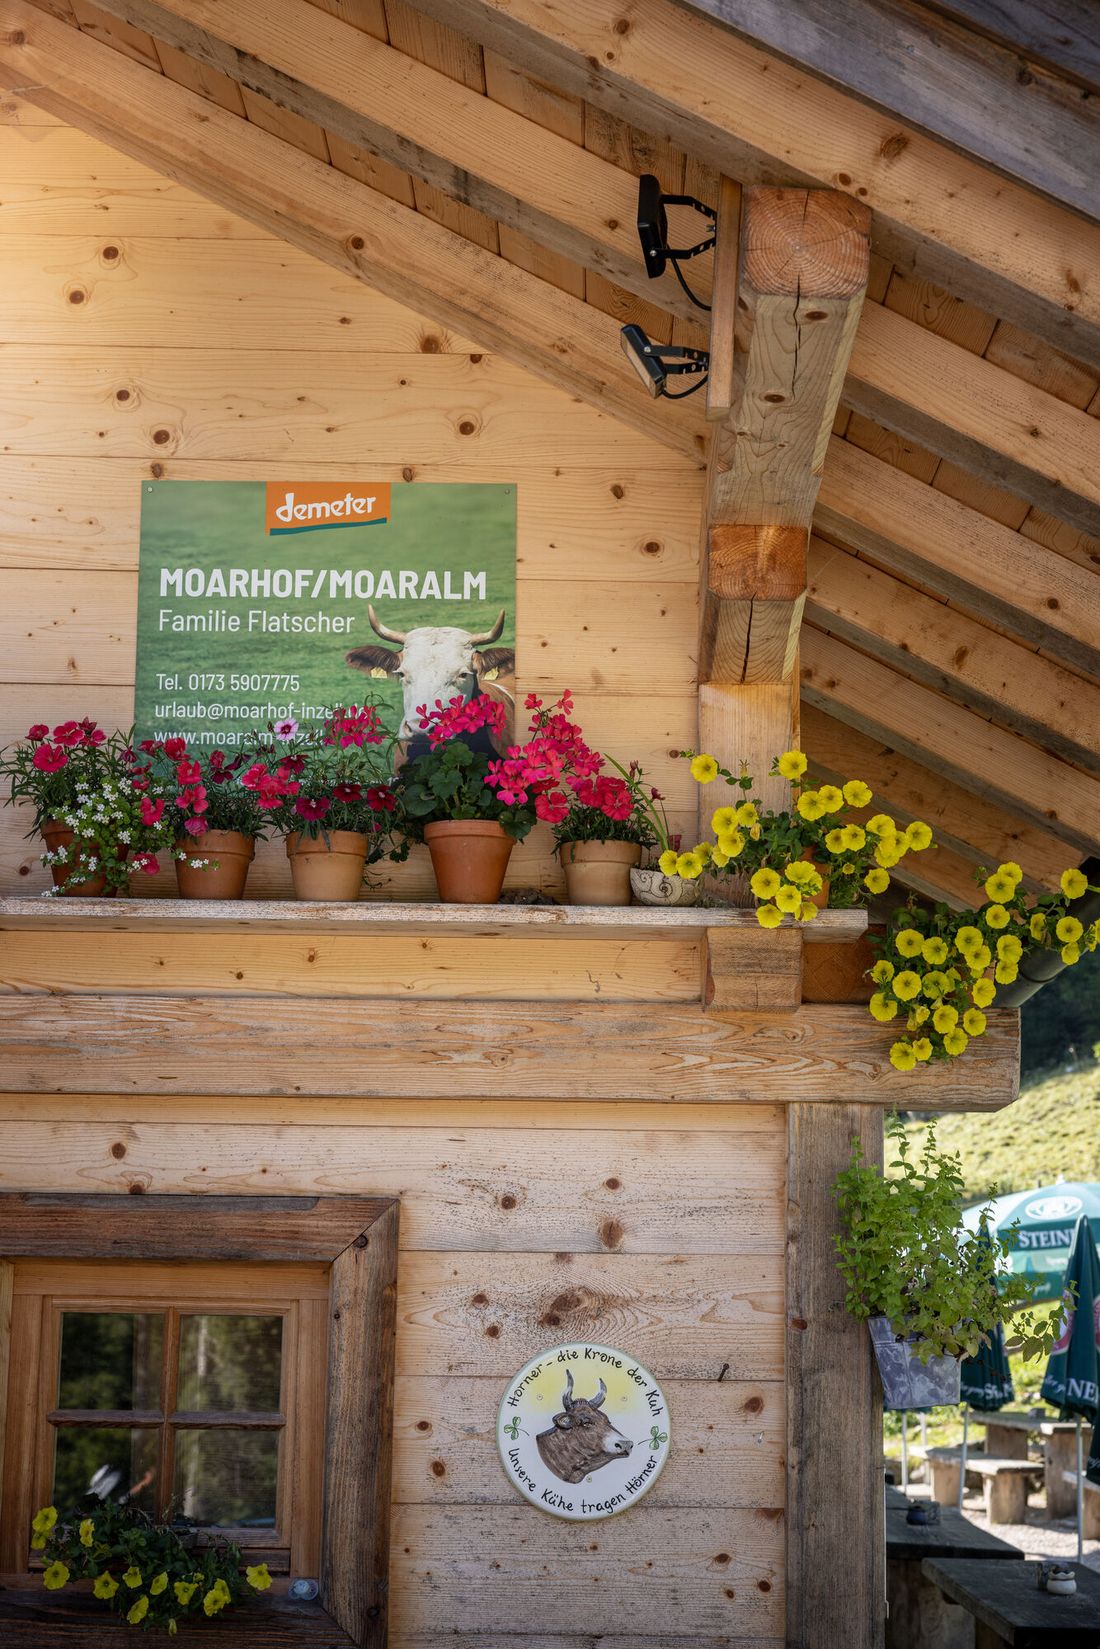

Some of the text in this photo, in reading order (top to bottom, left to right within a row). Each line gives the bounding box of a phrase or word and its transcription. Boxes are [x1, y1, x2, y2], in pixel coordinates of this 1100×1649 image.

[276, 492, 376, 523] demeter
[159, 568, 487, 600] MOARHOF/MOARALM
[158, 609, 355, 633] Familie Flatscher
[156, 673, 300, 692] Tel. 0173 5907775
[1018, 1227, 1075, 1249] STEIN
[557, 1349, 579, 1363] die
[584, 1347, 622, 1369] Krone
[627, 1367, 648, 1388] der
[645, 1389, 664, 1417] Kuh
[508, 1448, 657, 1514] Unsere Kühe tragen Hörner
